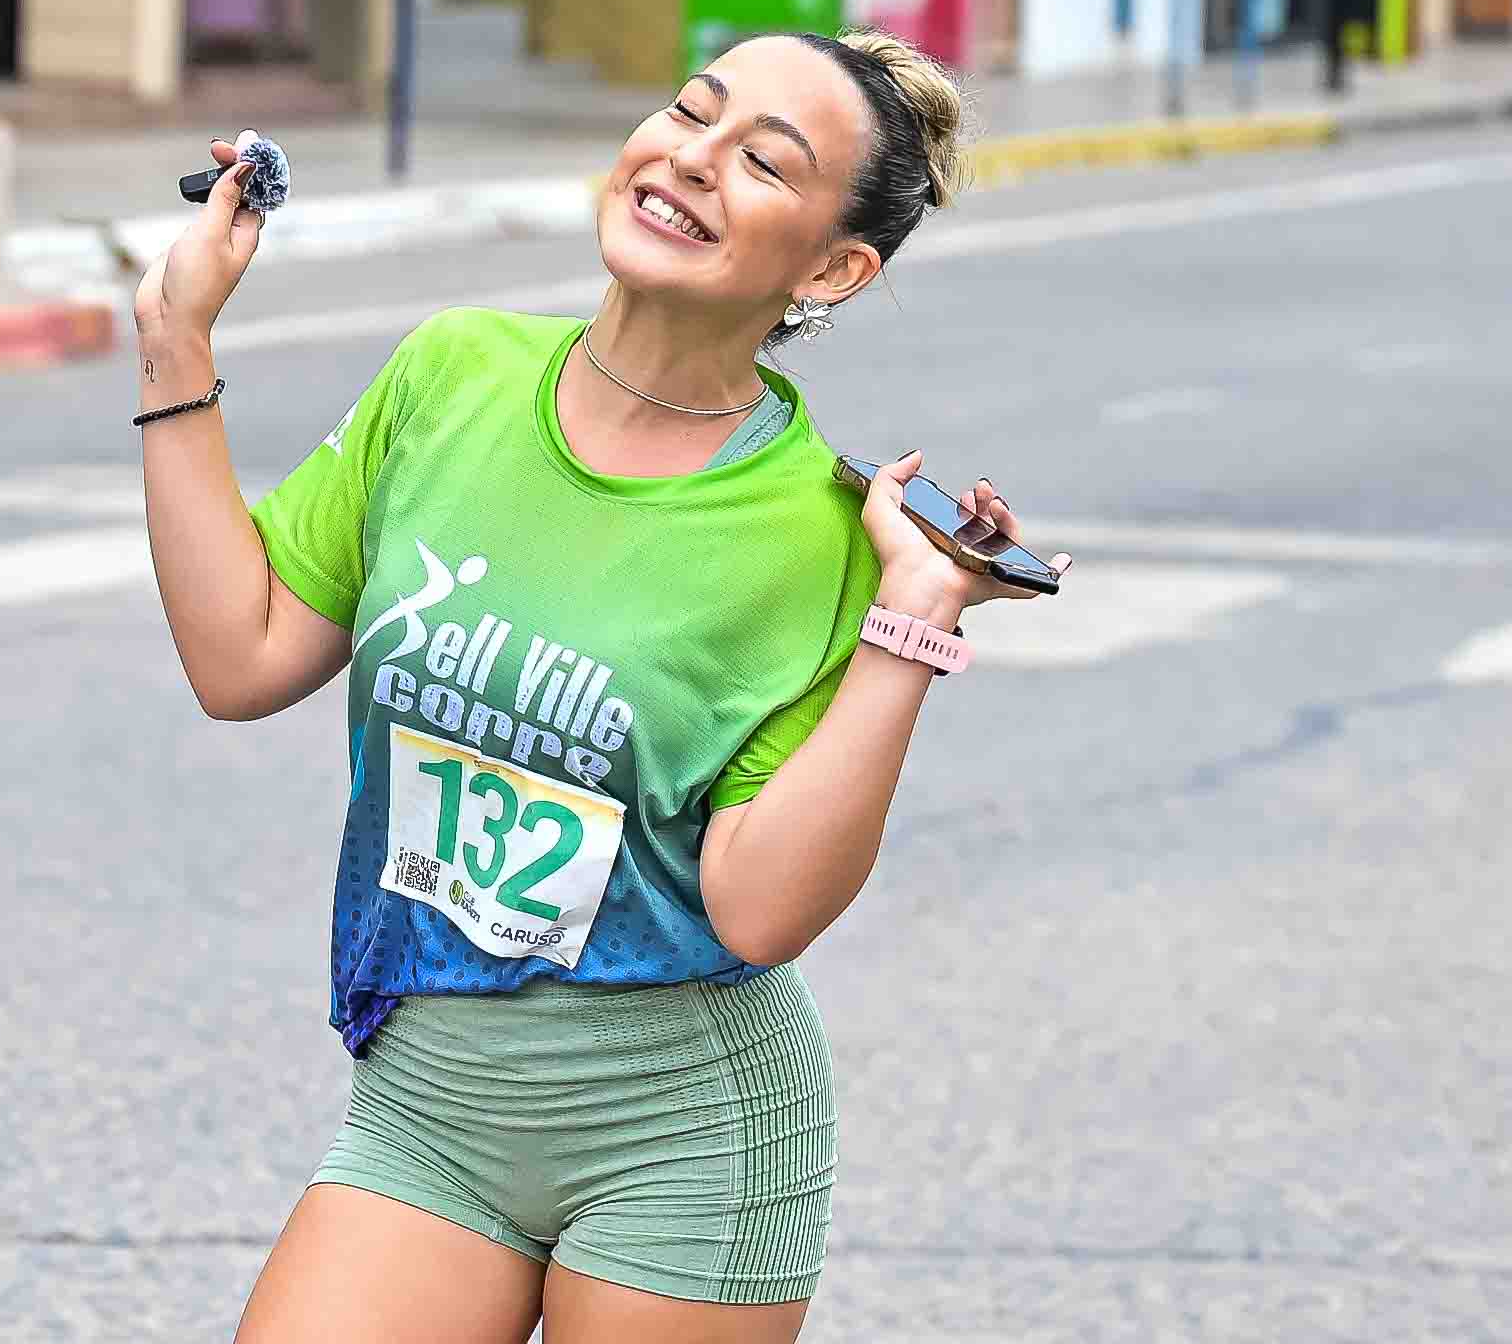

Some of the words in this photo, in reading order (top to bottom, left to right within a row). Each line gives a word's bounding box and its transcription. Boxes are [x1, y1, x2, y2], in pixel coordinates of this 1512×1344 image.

[514, 635, 633, 750] Ville
[419, 759, 583, 921] 132
[490, 922, 562, 945] CARUSO
